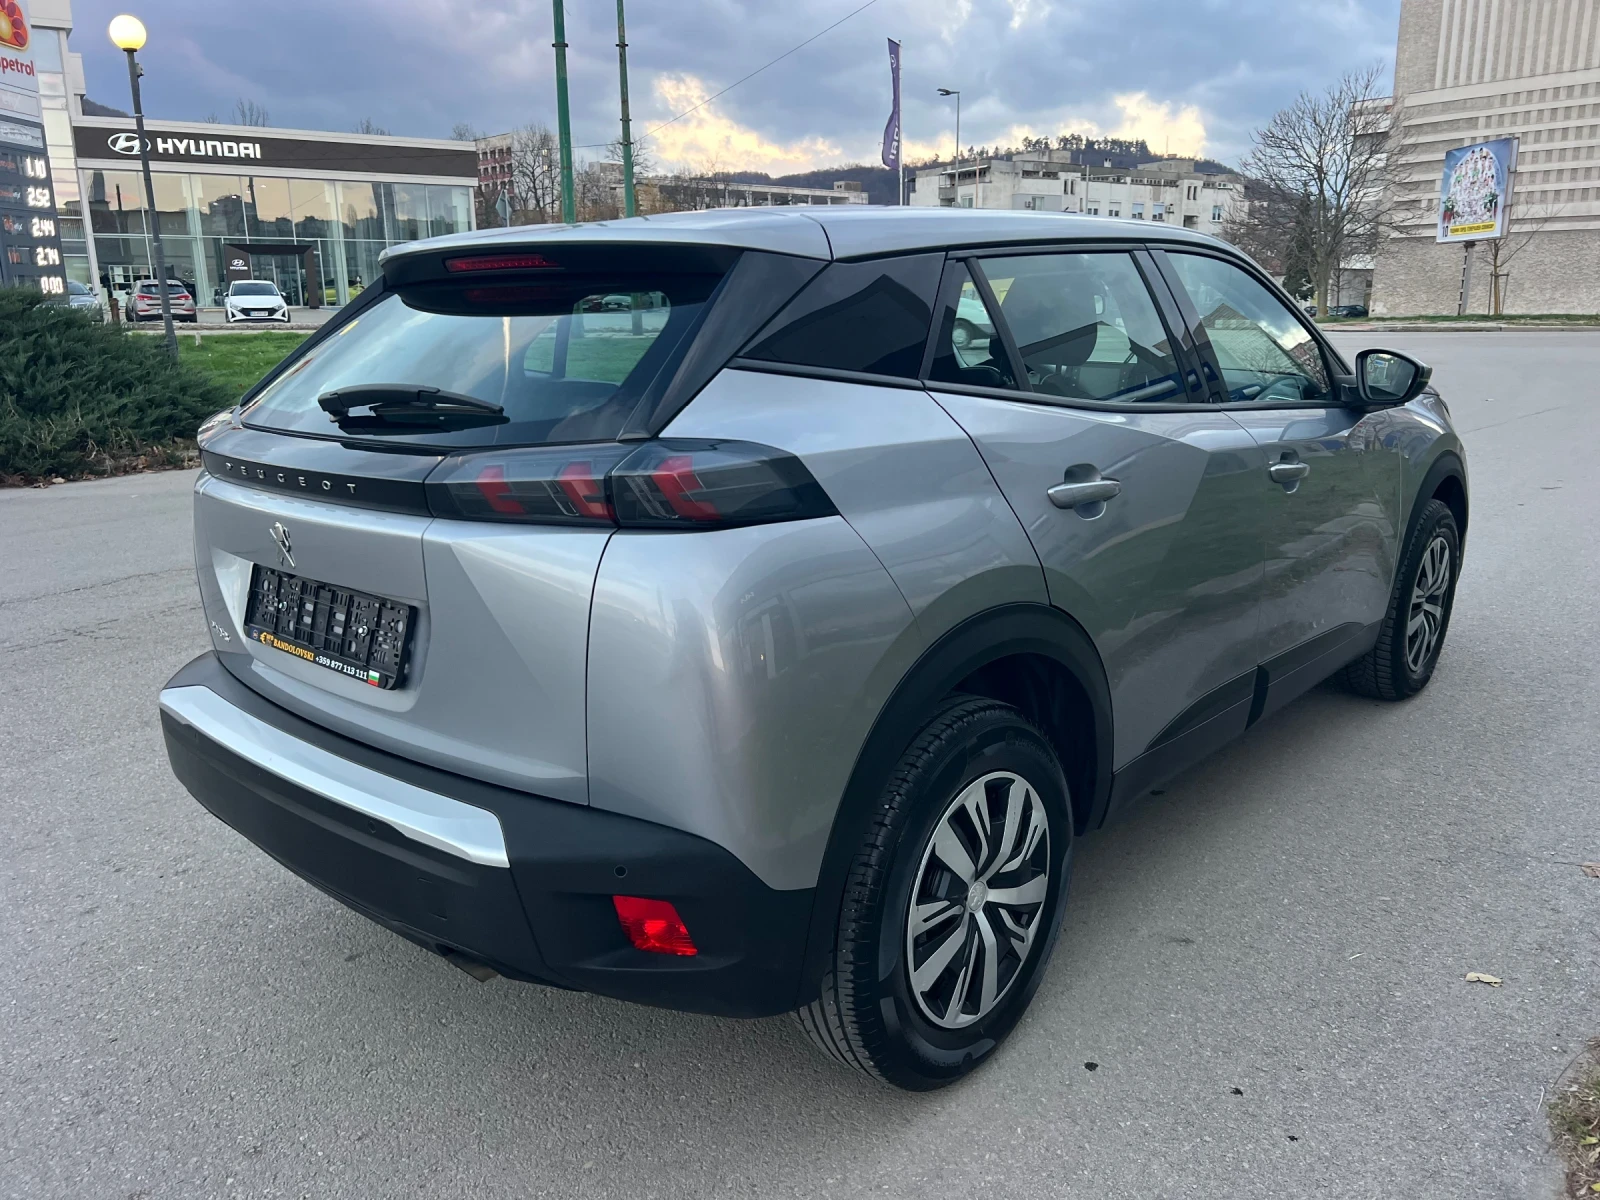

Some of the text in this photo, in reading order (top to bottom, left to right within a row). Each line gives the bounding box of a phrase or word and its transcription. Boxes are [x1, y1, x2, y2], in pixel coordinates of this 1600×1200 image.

[0, 56, 35, 77] petrol
[156, 137, 262, 159] HYUNDAI
[225, 462, 356, 494] PEUGEOT
[272, 638, 314, 662] BANDOLOVSKI
[315, 655, 331, 667] +359
[330, 659, 343, 672] 877
[342, 664, 356, 676] 113
[355, 668, 368, 680] 111
